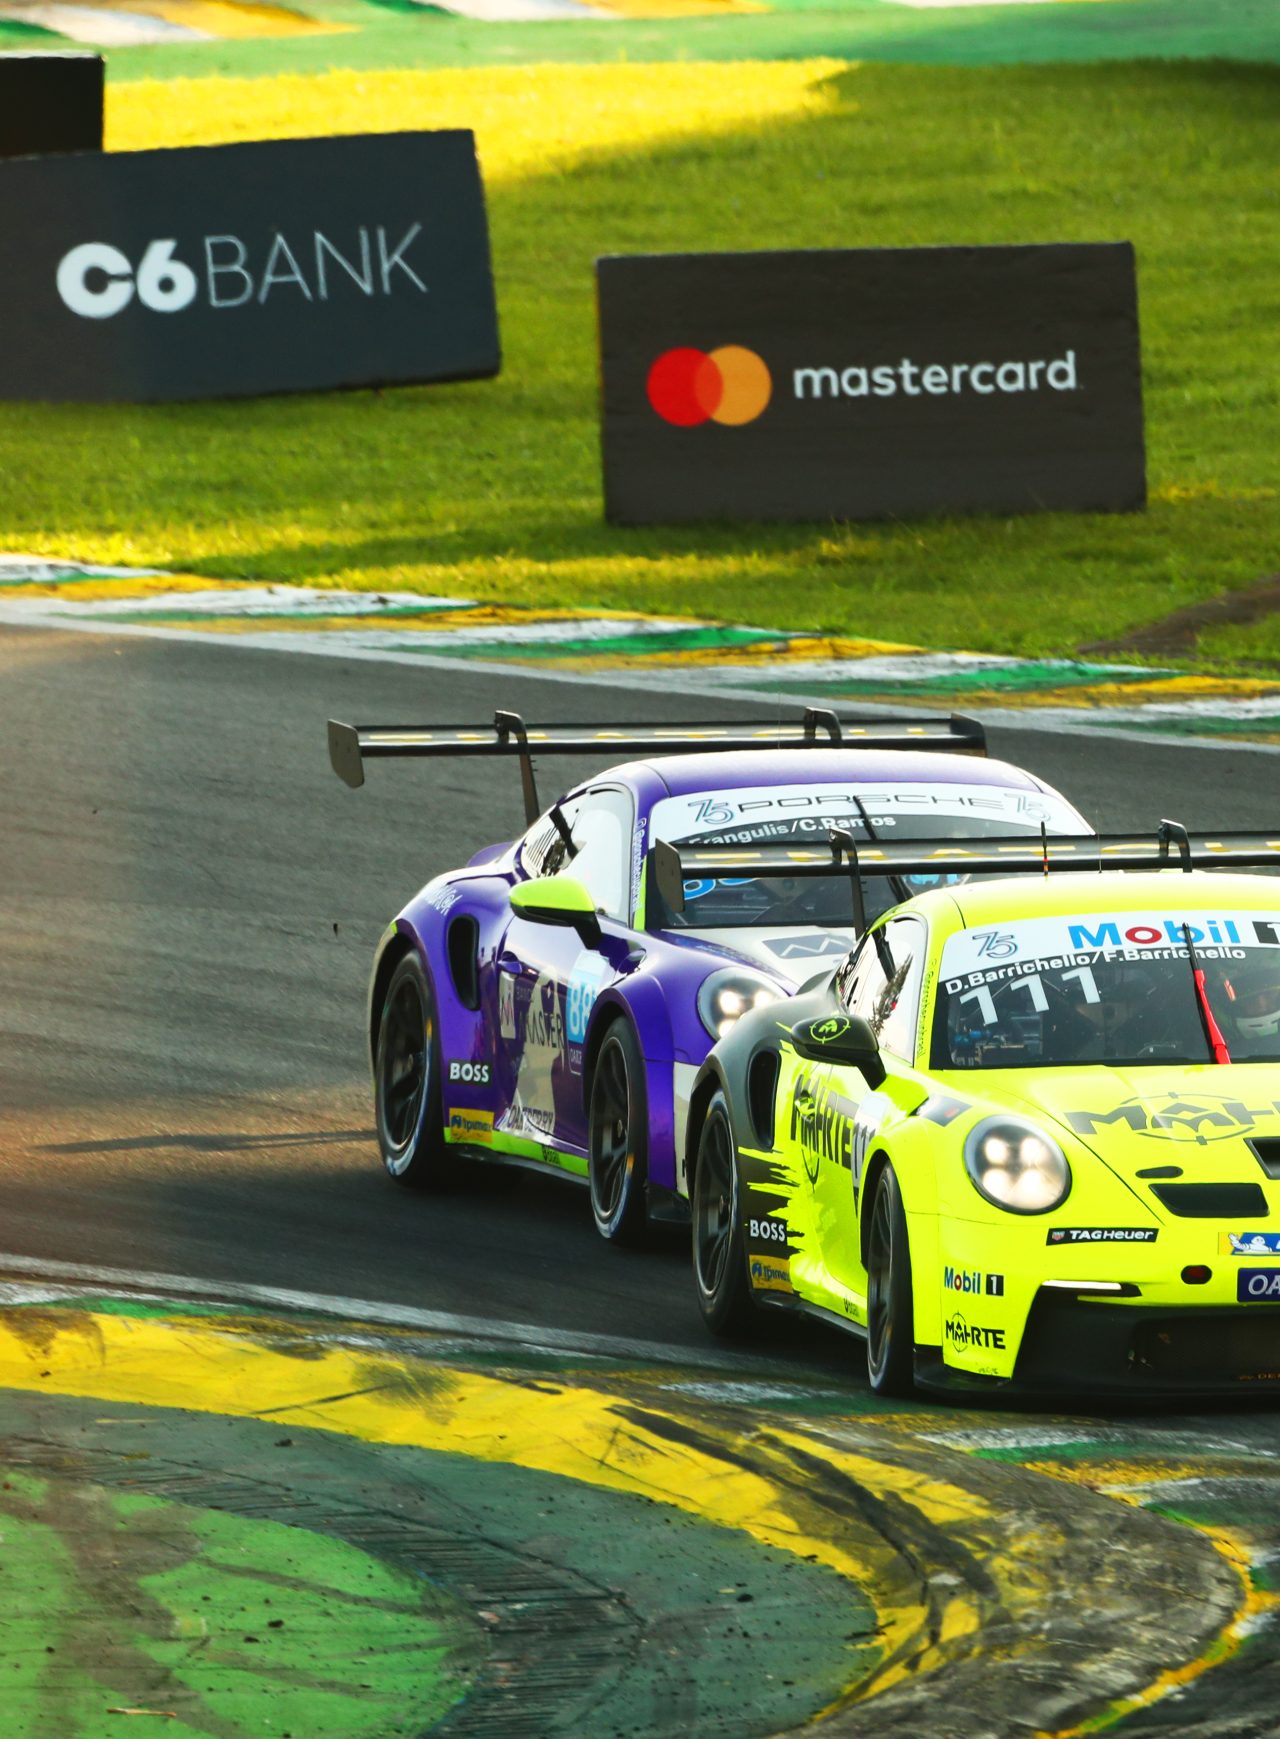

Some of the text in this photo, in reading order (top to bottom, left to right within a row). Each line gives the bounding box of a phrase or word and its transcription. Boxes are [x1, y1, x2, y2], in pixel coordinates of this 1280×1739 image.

[56, 221, 428, 319] C6 BANK
[793, 350, 1077, 398] mastercard
[738, 793, 1005, 812] PORSCHE
[1068, 920, 1241, 949] Mobil
[959, 966, 1101, 1026] 111
[450, 1062, 489, 1083] BOSS
[750, 1219, 786, 1242] BOSS
[944, 1266, 981, 1295] Mobil
